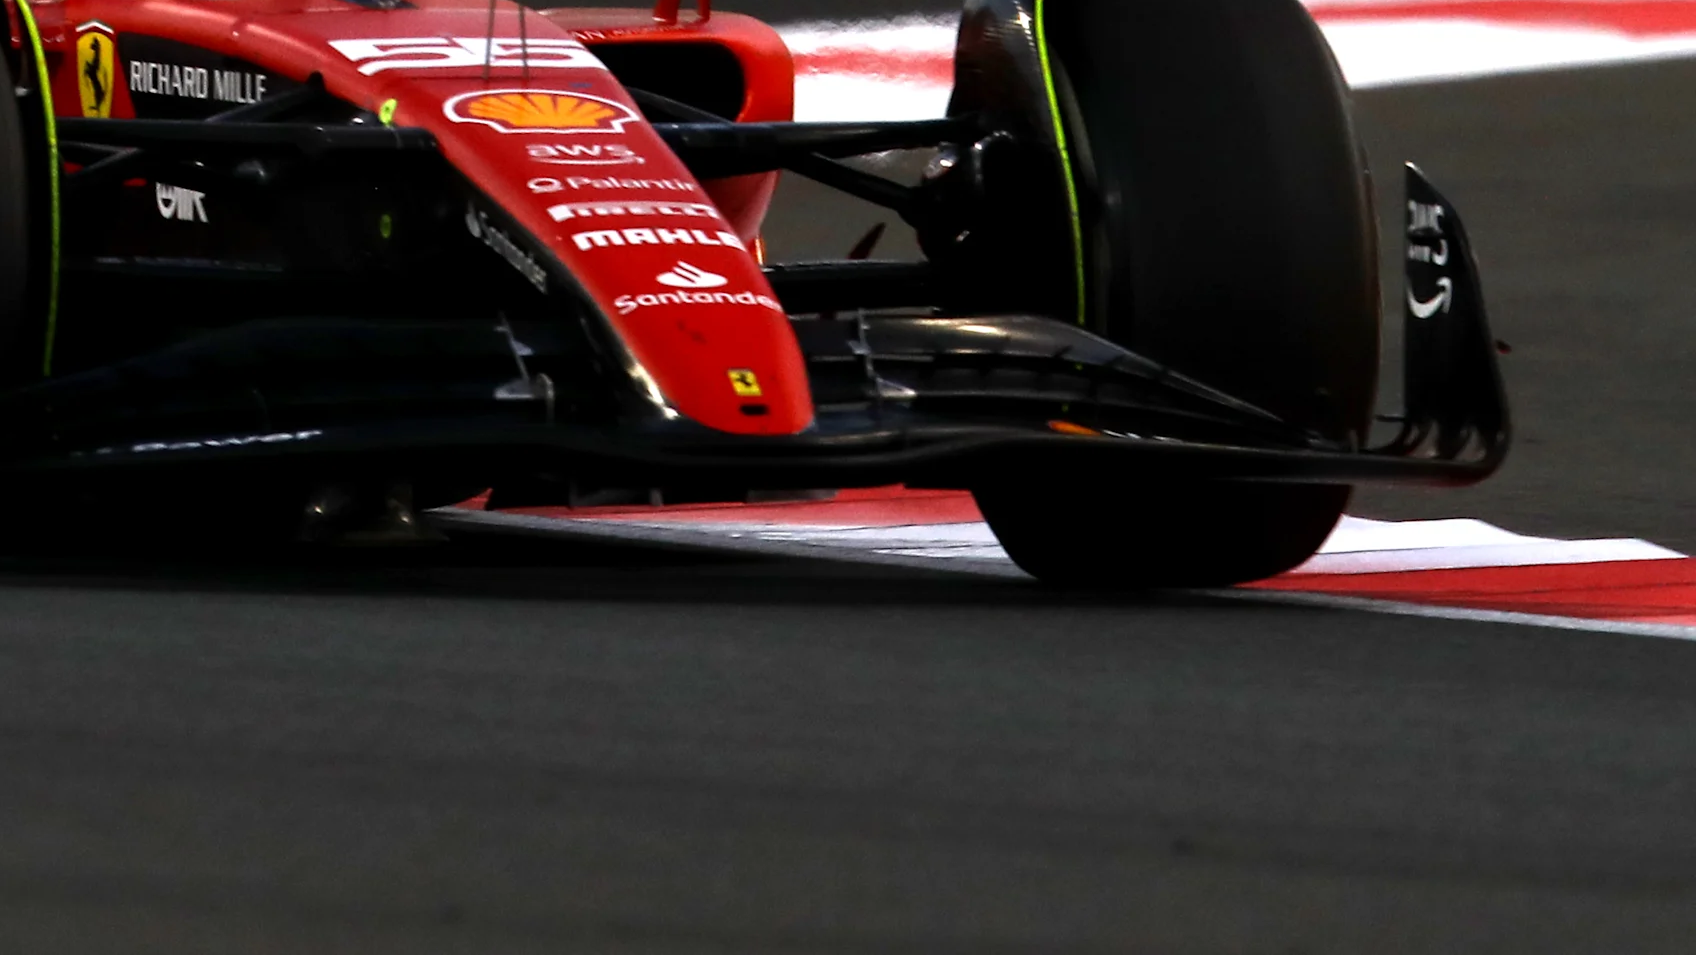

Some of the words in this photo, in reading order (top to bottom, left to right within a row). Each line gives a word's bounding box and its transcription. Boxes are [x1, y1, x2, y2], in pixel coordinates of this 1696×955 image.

[327, 36, 609, 76] 55
[129, 59, 209, 99] RICHARD
[526, 144, 638, 160] aws
[566, 176, 698, 193] Palantir
[571, 227, 747, 252] MAHLE
[614, 290, 786, 315] Santande
